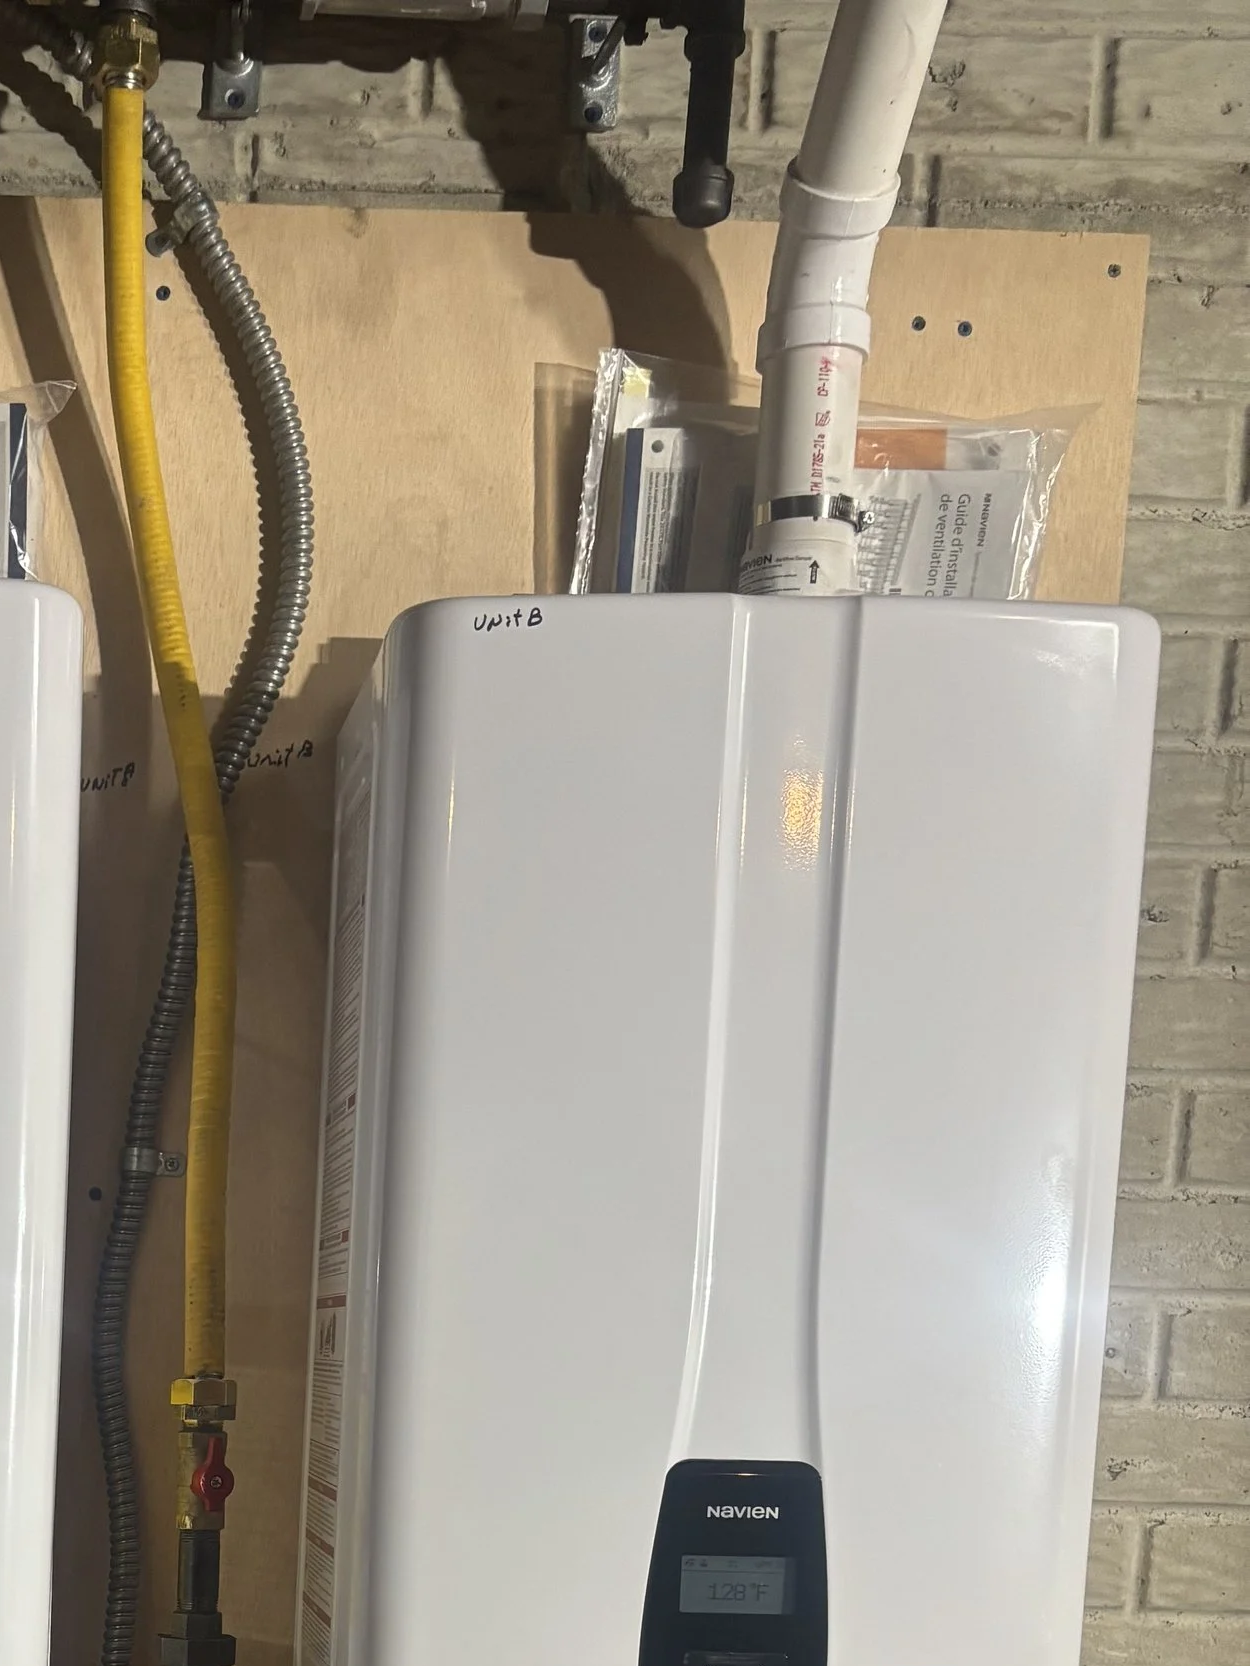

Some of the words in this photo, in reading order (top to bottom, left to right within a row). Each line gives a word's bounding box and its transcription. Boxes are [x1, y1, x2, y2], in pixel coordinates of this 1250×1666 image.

[939, 493, 953, 512] de
[953, 493, 971, 535] Guide
[926, 514, 948, 587] ventilation
[527, 606, 543, 627] B
